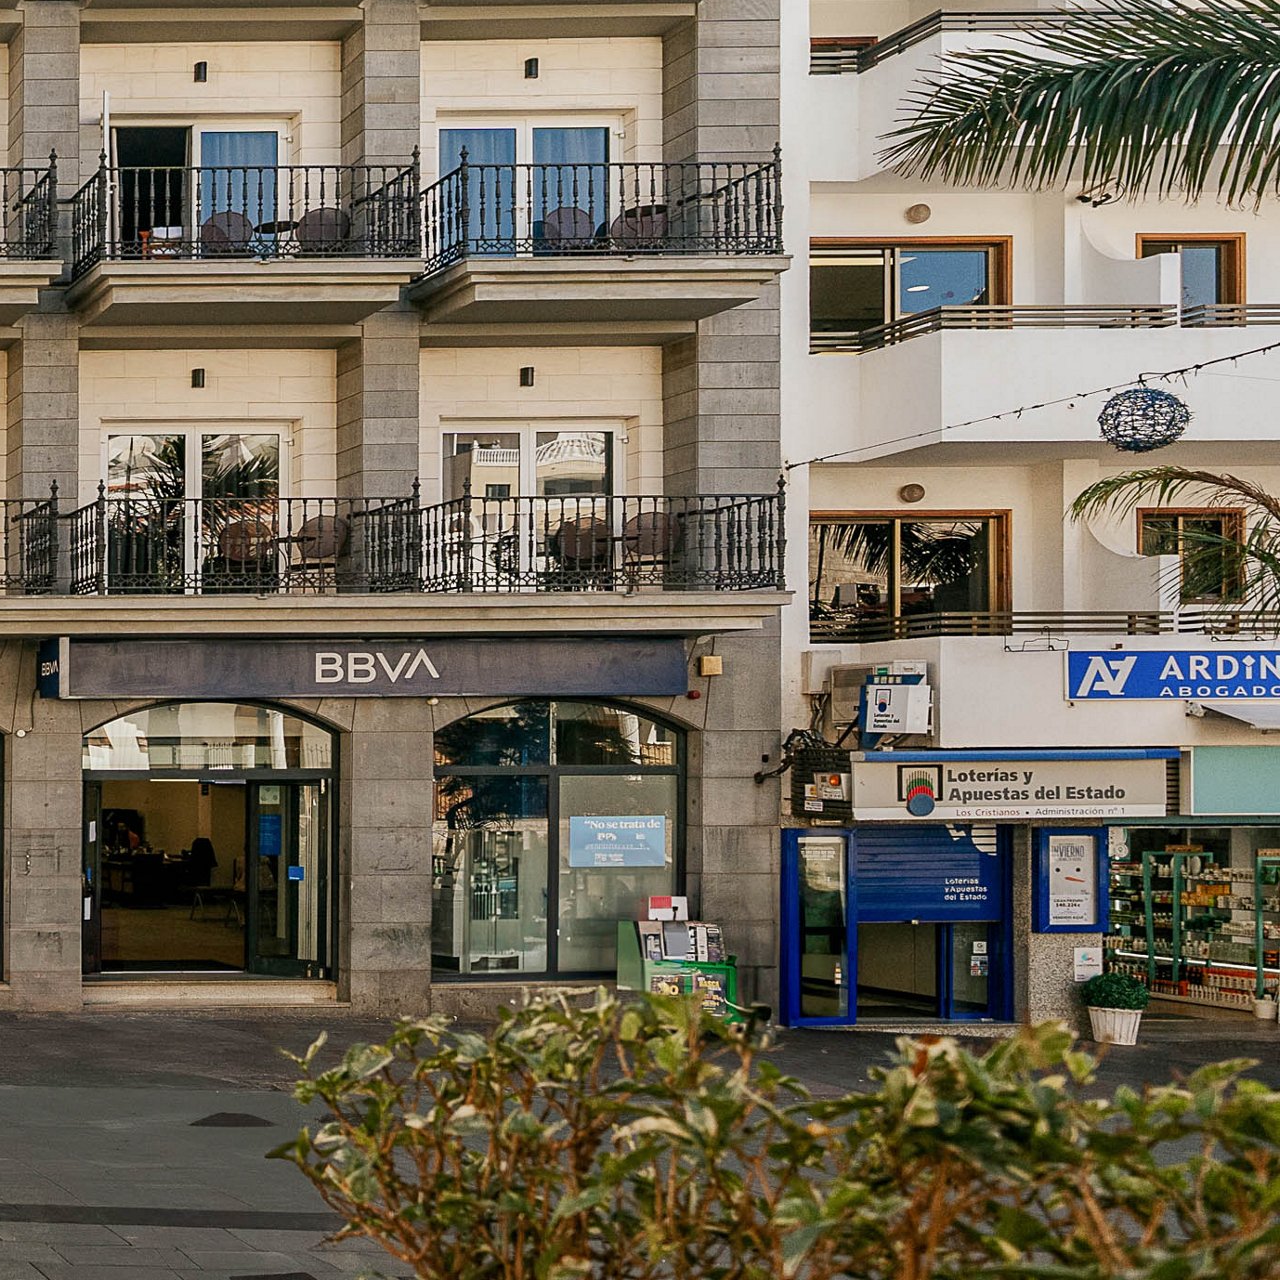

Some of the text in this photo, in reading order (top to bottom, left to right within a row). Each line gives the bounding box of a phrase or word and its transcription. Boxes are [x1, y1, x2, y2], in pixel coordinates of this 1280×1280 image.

[41, 659, 59, 676] BBVA
[315, 648, 440, 683] BBVA
[947, 768, 1034, 785] Loterías y
[948, 785, 1126, 804] Apuestas del Estado
[956, 809, 971, 817] Los
[975, 808, 1021, 817] Cristianos
[1035, 806, 1104, 816] Administración
[1121, 807, 1126, 815] 1
[620, 821, 645, 829] trata
[646, 819, 661, 829] de
[959, 893, 987, 901] Estado
